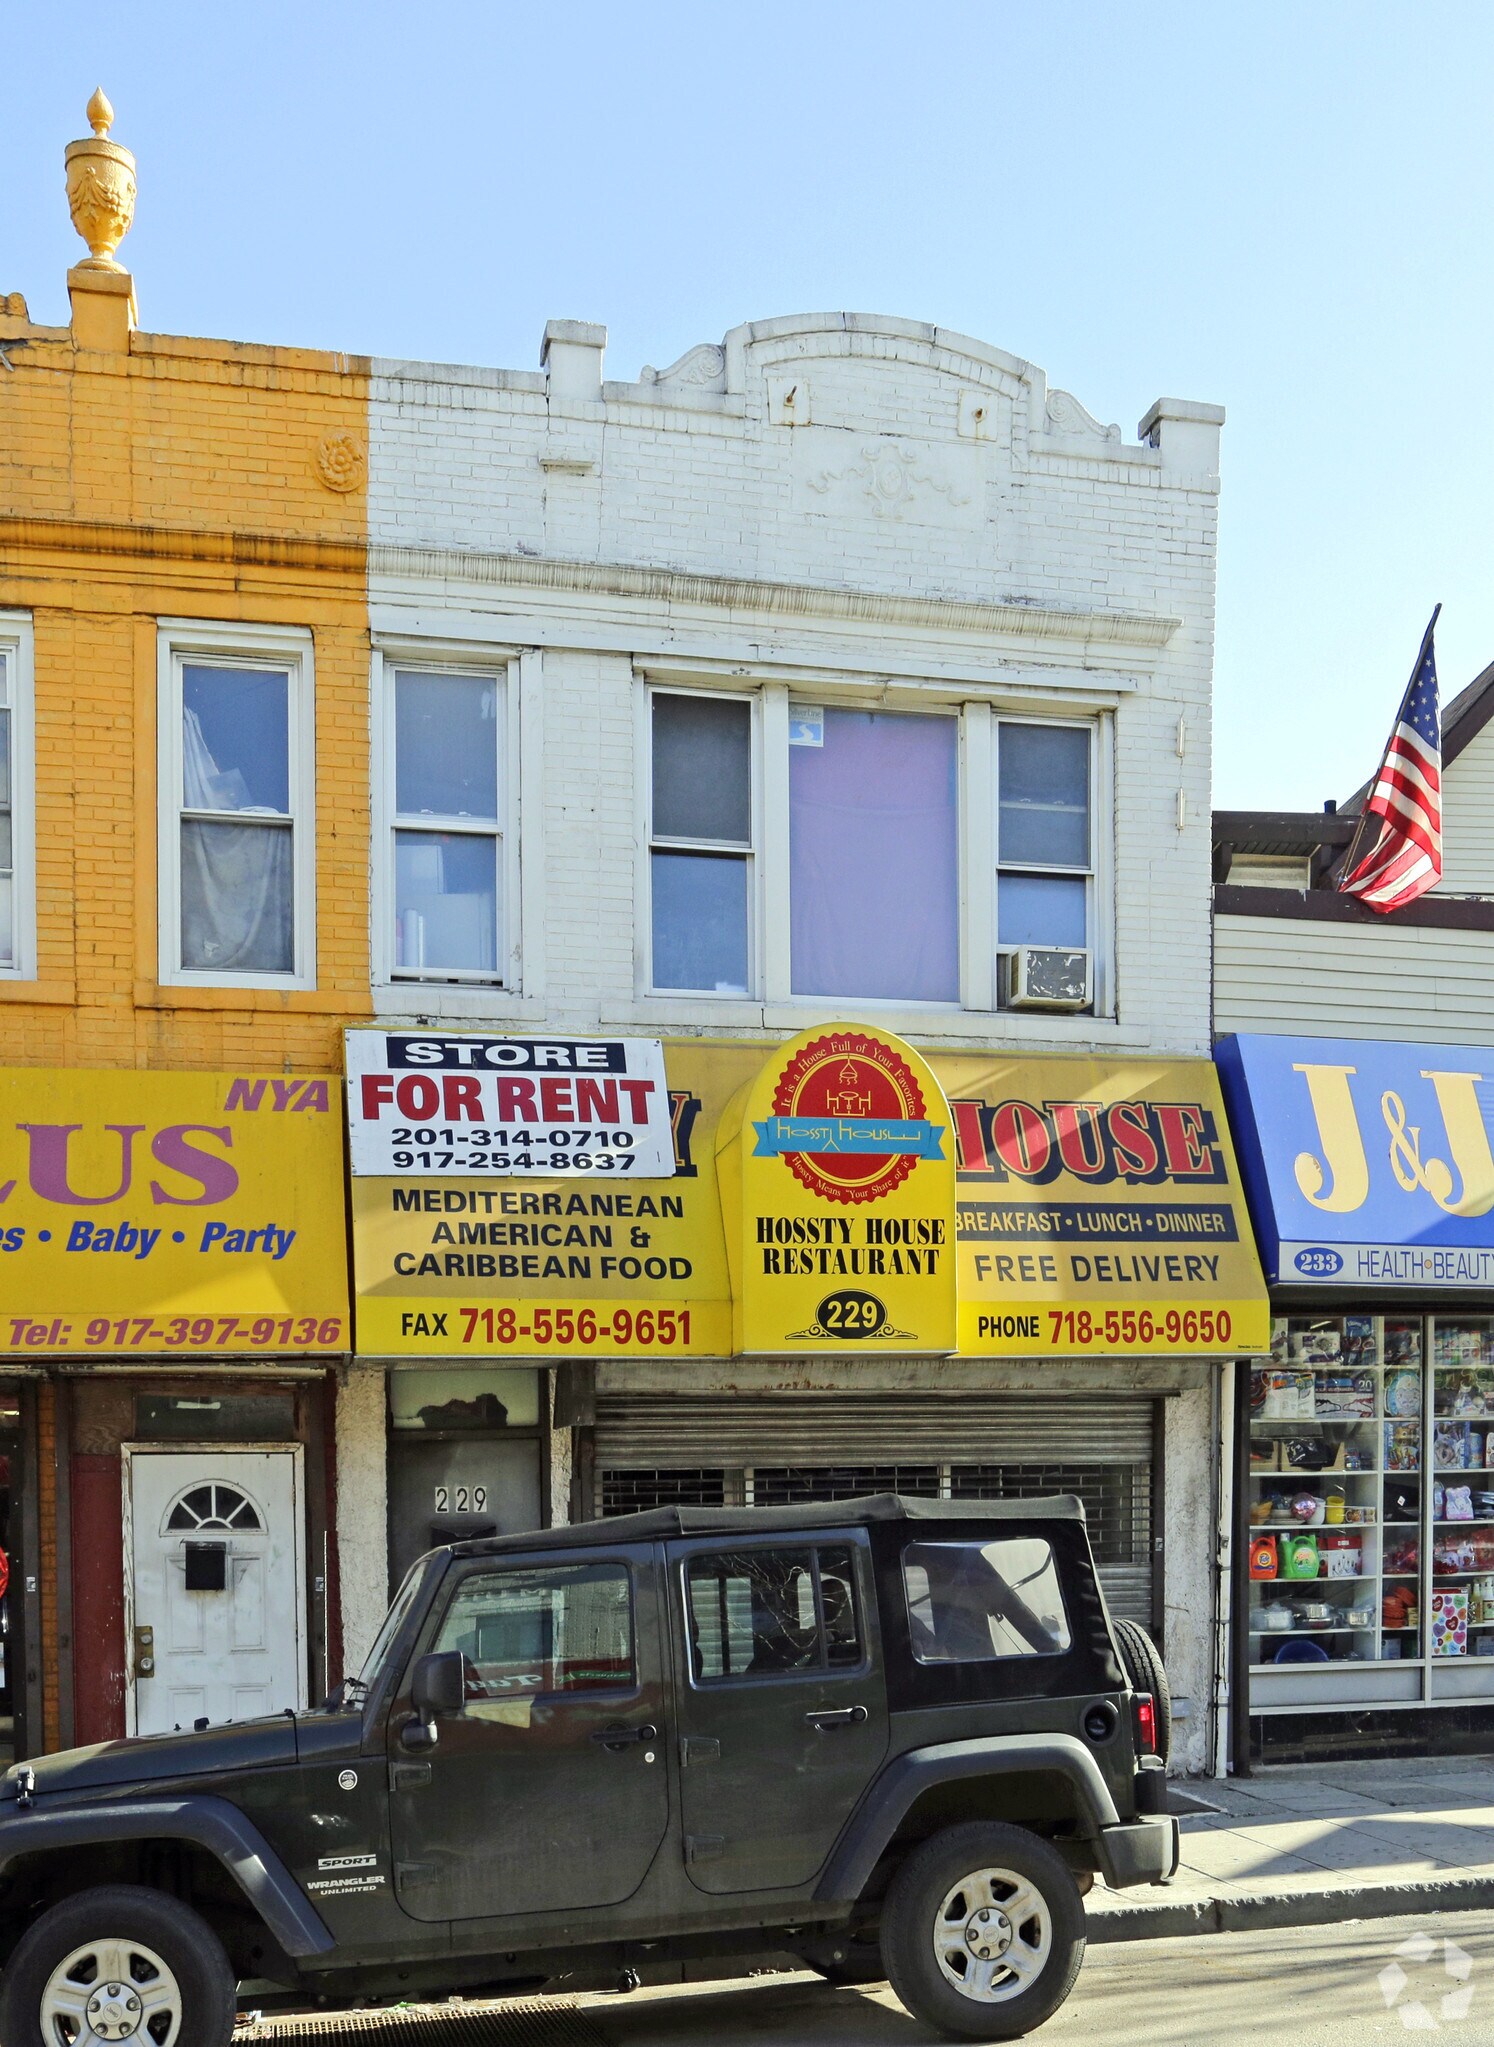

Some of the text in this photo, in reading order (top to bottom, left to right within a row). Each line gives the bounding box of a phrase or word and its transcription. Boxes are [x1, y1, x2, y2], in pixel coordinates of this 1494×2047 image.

[404, 1042, 610, 1068] STORE
[831, 1041, 850, 1051] Full
[855, 1043, 868, 1054] of
[873, 1047, 894, 1069] Your
[798, 1048, 827, 1073] House
[224, 1079, 329, 1112] NYA
[361, 1074, 655, 1125] FOR RENT
[785, 1084, 796, 1093] is
[894, 1068, 917, 1117] Favorites
[781, 1098, 792, 1108] It
[391, 1128, 634, 1148] 201-314-0710
[0, 1124, 239, 1206] US
[393, 1151, 636, 1171] 917-254-8637
[791, 1156, 814, 1182] Hossty
[816, 1179, 841, 1197] Means
[871, 1179, 893, 1195] Share
[894, 1168, 903, 1180] of
[392, 1188, 684, 1218] MEDITERRANEAN
[431, 1222, 651, 1248] AMERICAN &
[756, 1217, 945, 1245] HOSSTY HOUSE
[956, 1211, 1226, 1232] BREAKFAST LUNCH DINNER
[66, 1221, 161, 1260] Baby
[199, 1222, 296, 1260] Party
[393, 1253, 693, 1280] CARIBBEAN FOOD
[763, 1248, 940, 1275] RESTAURANT
[974, 1255, 1220, 1282] FREE DELIVERY
[1300, 1250, 1494, 1280] 233 HEALTH BEAUT
[401, 1307, 691, 1345] FAX 718-556-9651
[827, 1300, 878, 1328] 229
[978, 1310, 1232, 1344] PHONE 718-556-9650
[9, 1318, 342, 1346] Tel: 917-397-9136
[436, 1487, 487, 1512] 229
[321, 1858, 373, 1868] SPORT
[307, 1875, 386, 1890] WRANGLER
[320, 1885, 377, 1896] UNLIMITED
